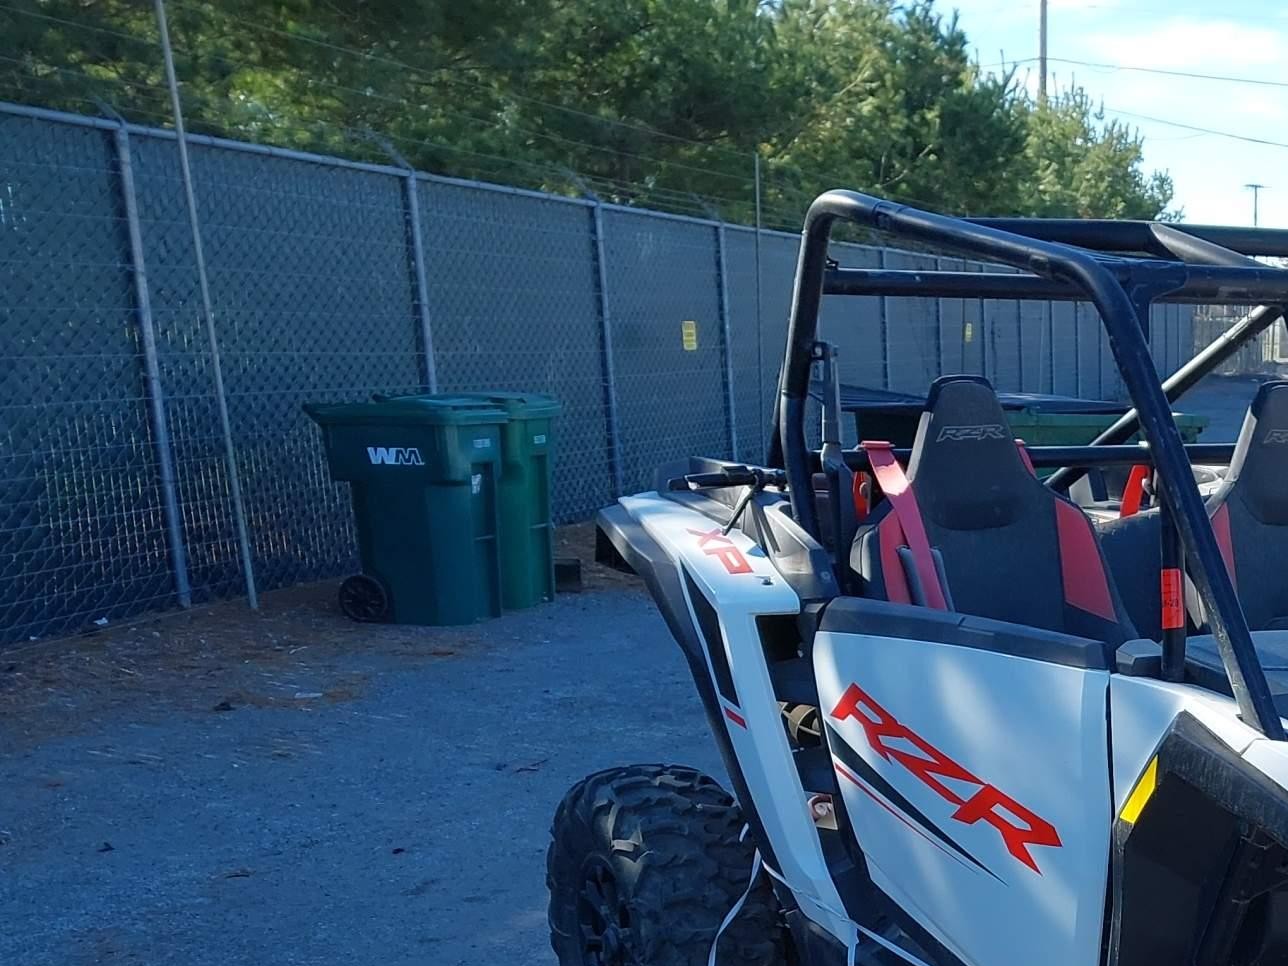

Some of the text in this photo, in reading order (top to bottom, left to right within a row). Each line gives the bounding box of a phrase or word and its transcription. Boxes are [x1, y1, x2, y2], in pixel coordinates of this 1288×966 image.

[936, 424, 1005, 442] RZR
[366, 446, 425, 466] WM
[686, 528, 754, 574] XP
[831, 682, 1063, 876] RZR
